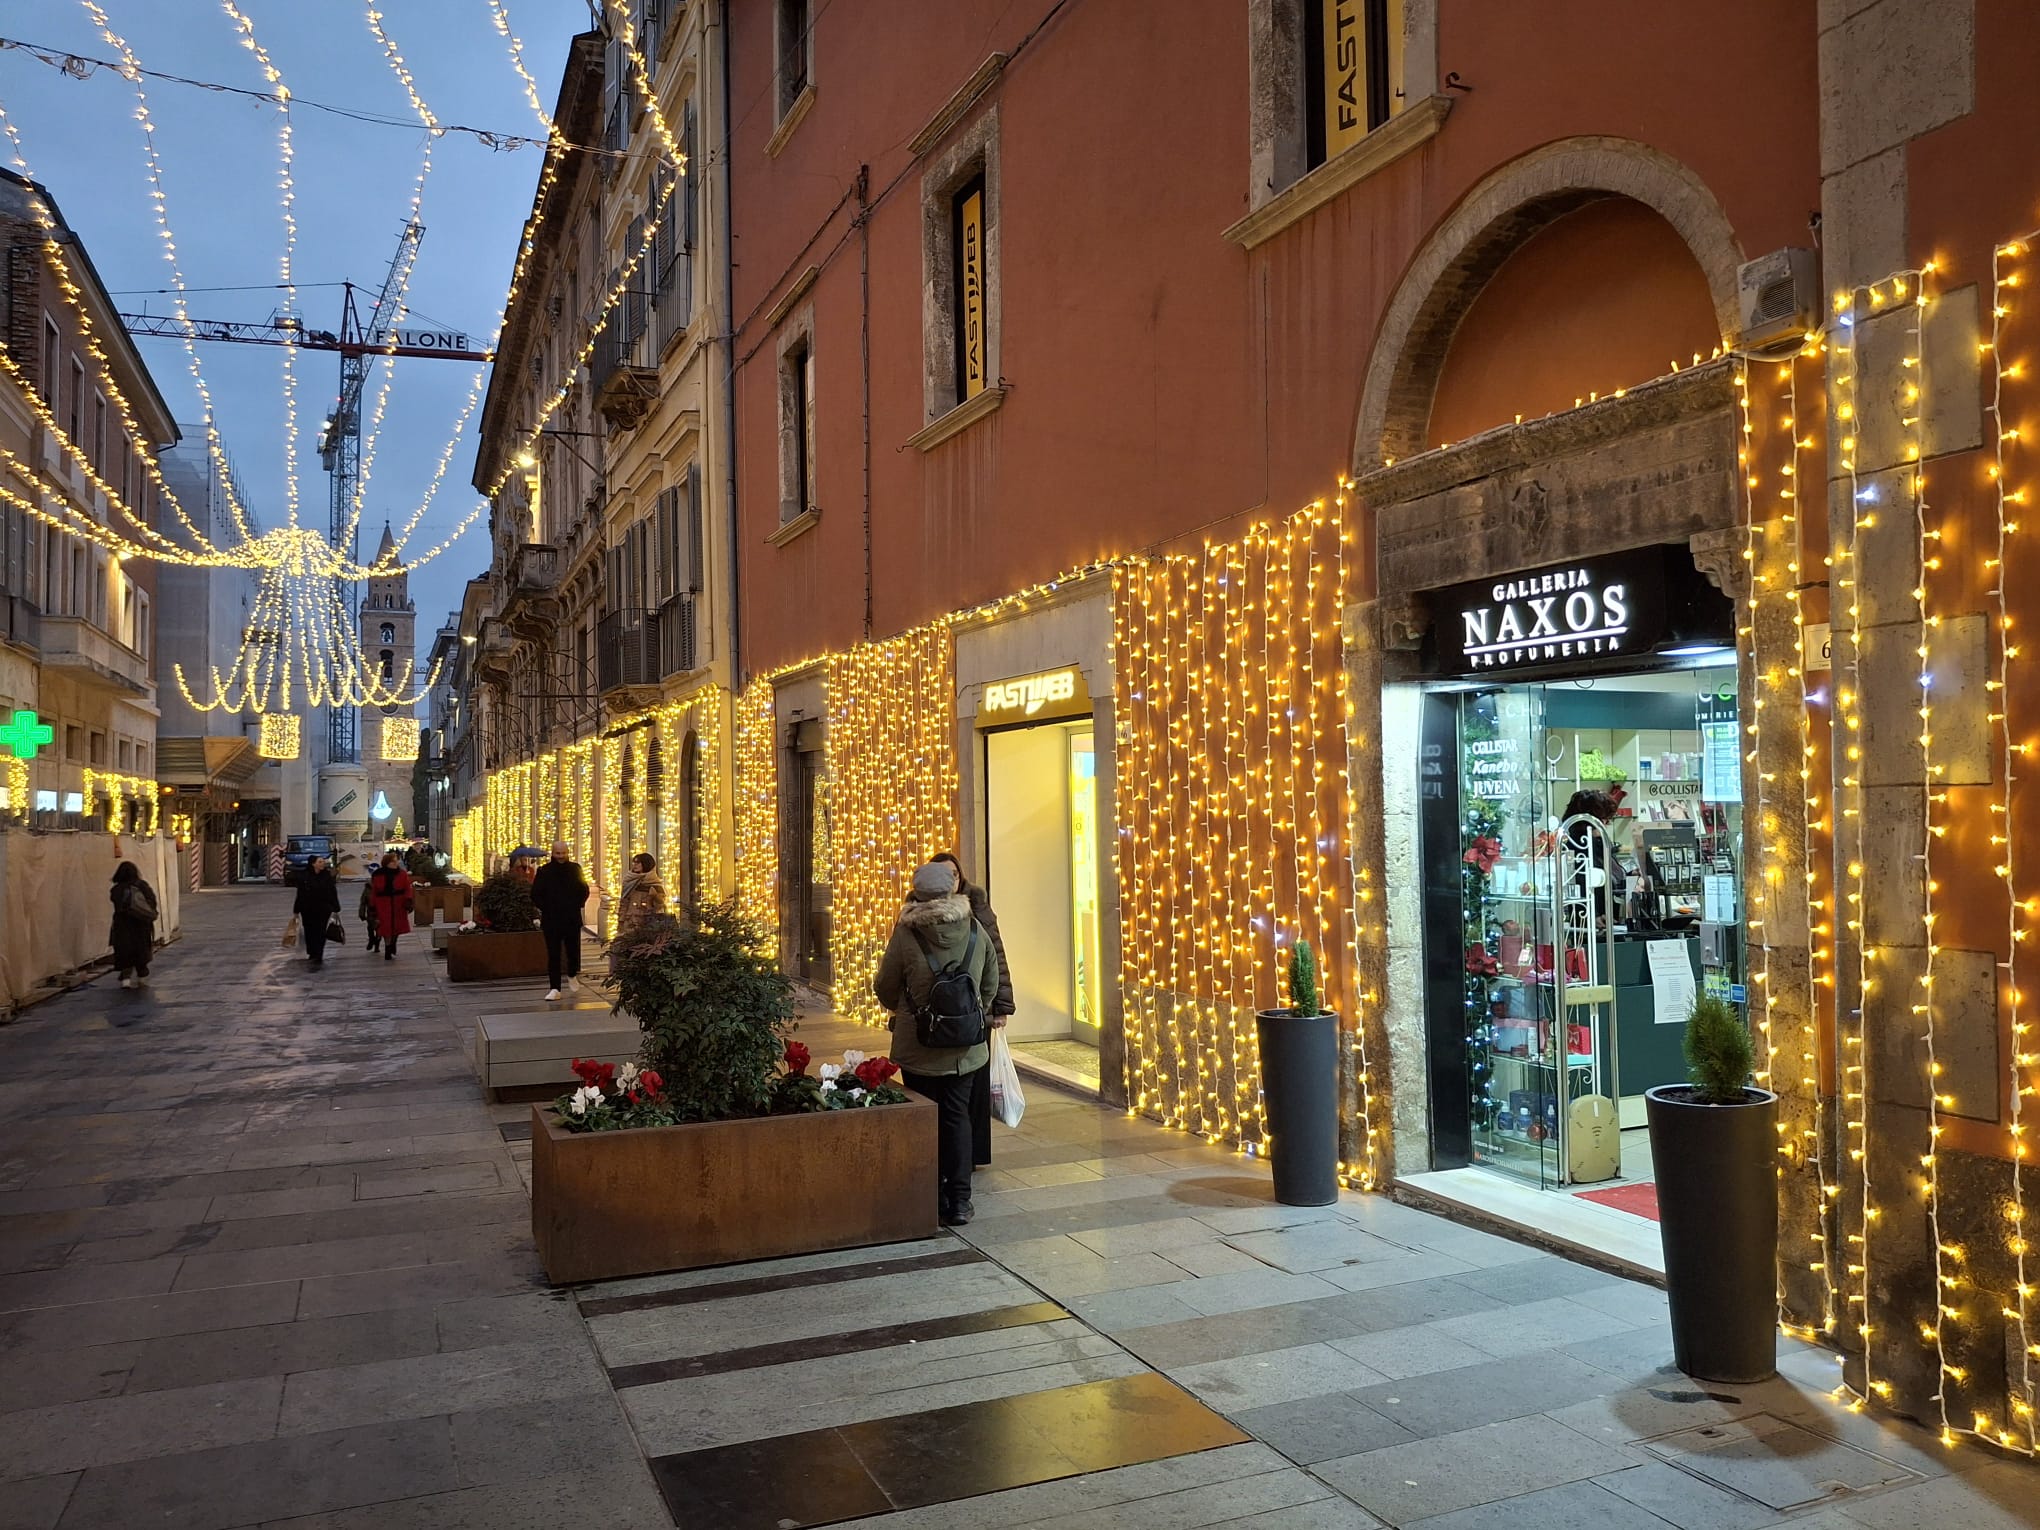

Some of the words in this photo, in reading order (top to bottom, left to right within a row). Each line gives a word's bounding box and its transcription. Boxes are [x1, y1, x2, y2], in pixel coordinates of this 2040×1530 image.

[1336, 0, 1358, 131] FAST
[967, 222, 980, 381] FASTWEB
[376, 330, 466, 350] FALONE
[1492, 569, 1590, 602] GALLERIA
[1461, 584, 1627, 648] NAXOS
[1470, 635, 1621, 668] PROFUMERIA
[985, 671, 1075, 715] FASTWEB
[1472, 739, 1519, 755] COLLISTAR
[1472, 759, 1518, 774] Kanebo
[1473, 779, 1521, 798] JUVENA
[1659, 784, 1702, 795] COLLISTA
